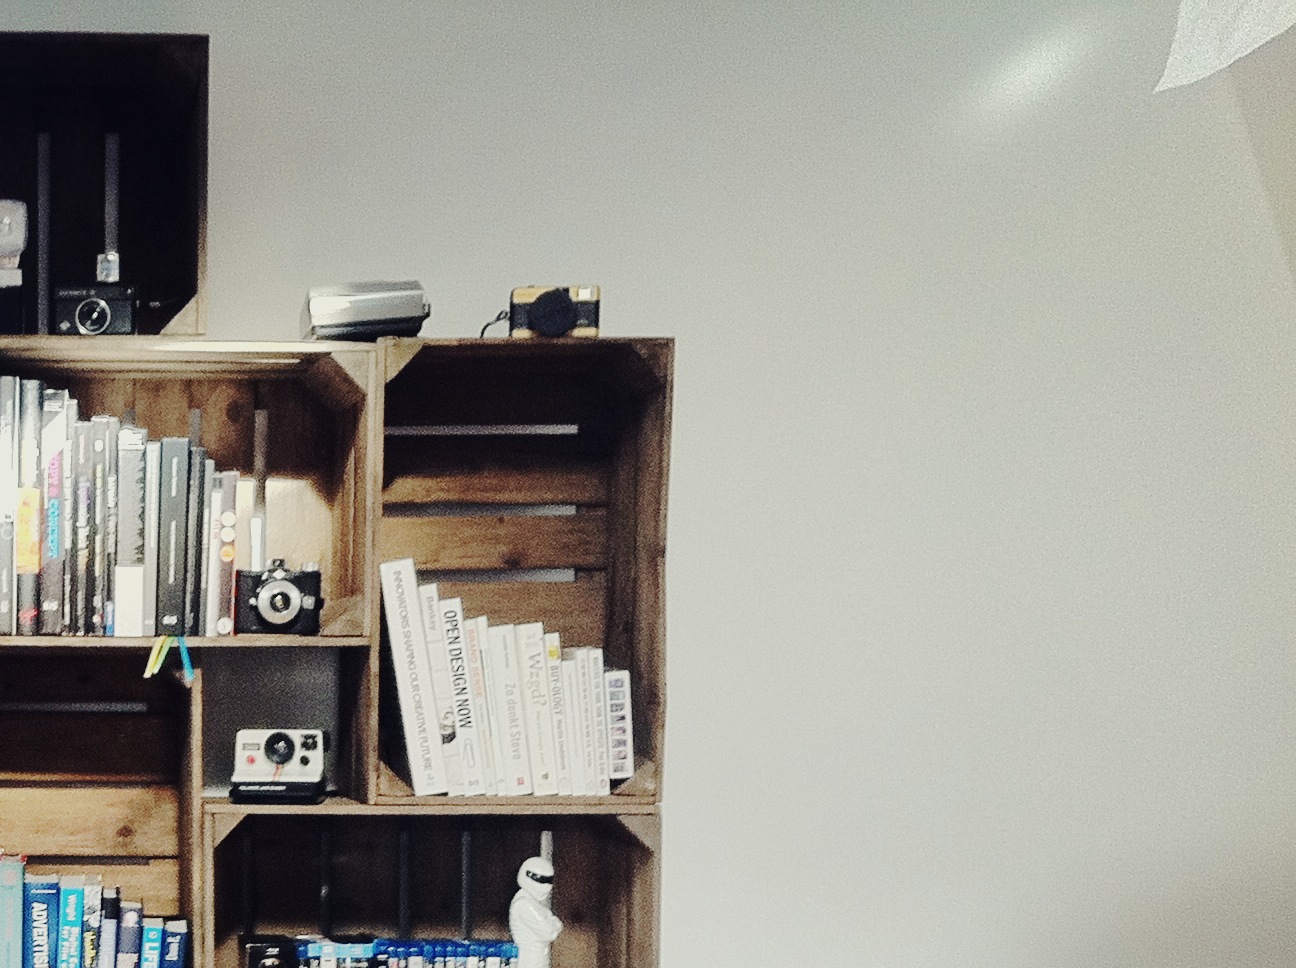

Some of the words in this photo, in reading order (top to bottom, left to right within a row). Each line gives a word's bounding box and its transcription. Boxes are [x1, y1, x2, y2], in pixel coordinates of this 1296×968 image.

[392, 570, 410, 629] INNOVATORS
[443, 610, 460, 645] OPEN
[408, 672, 420, 693] OUR
[449, 648, 467, 696] DESIGN
[412, 693, 427, 736] CREATIVE
[456, 699, 472, 729] NOW
